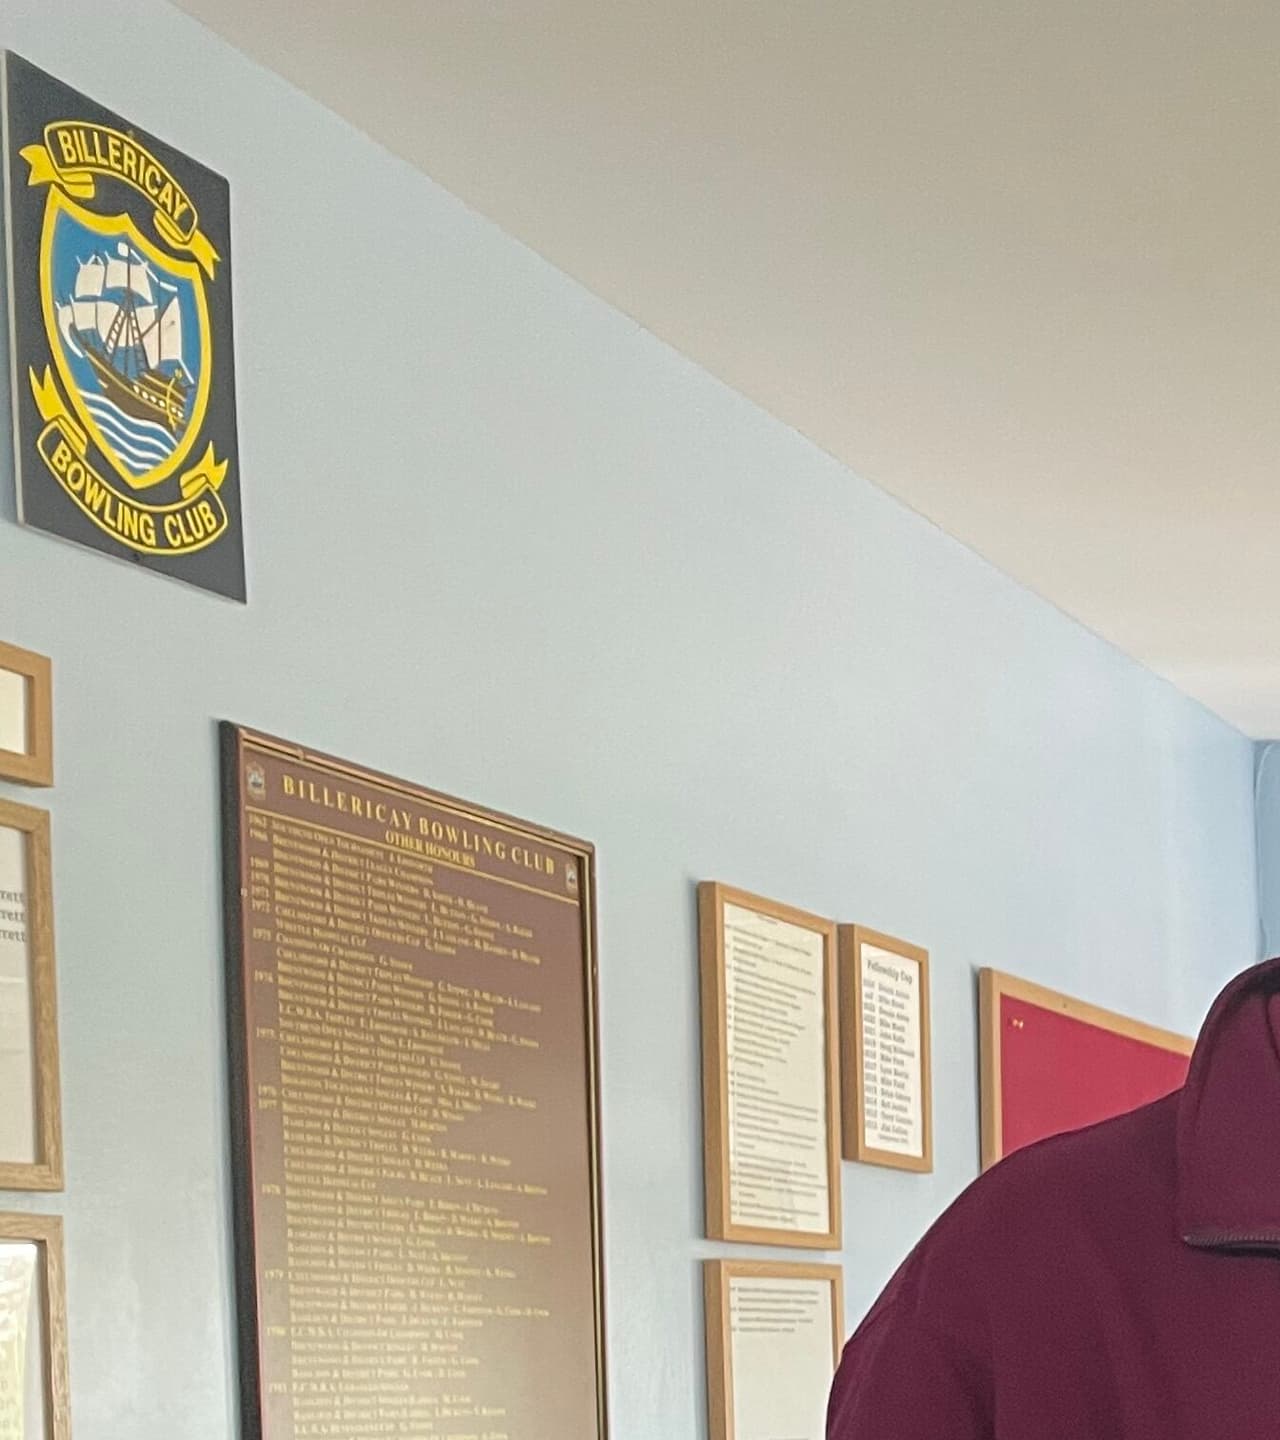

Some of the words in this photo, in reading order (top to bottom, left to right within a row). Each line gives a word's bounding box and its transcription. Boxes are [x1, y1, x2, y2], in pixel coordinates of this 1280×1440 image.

[57, 129, 189, 223] BILLERICAY
[49, 439, 157, 549] BOWLING
[163, 501, 218, 550] CLUB
[282, 774, 412, 832] BILLERICAY
[418, 817, 506, 860] BOWLING
[511, 847, 555, 875] CLUB
[384, 830, 423, 853] OTHER
[424, 843, 476, 868] HONOURS
[867, 960, 898, 981] Fellowship
[900, 971, 912, 984] Cup
